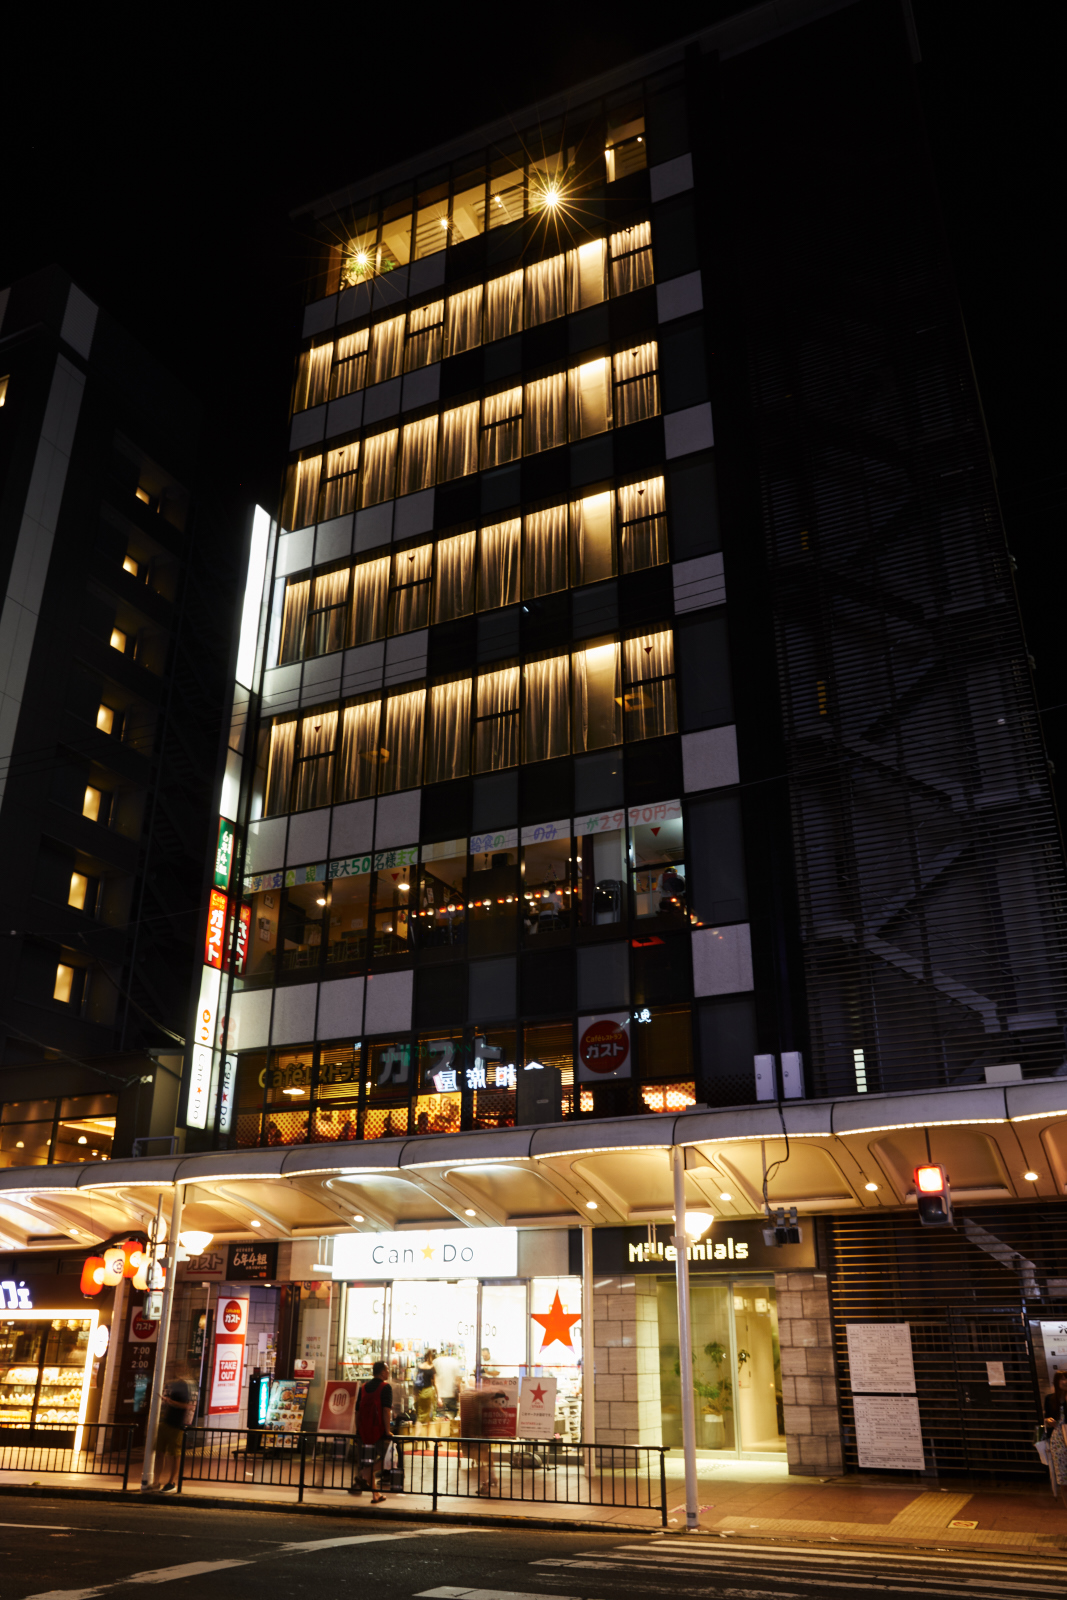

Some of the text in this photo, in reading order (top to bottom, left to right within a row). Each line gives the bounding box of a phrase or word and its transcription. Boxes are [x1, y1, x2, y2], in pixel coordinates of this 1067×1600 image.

[208, 909, 225, 962] ガスト
[586, 1042, 624, 1059] ガスト
[377, 1036, 503, 1086] ガスト
[233, 1252, 268, 1267] 6年4組
[372, 1244, 474, 1264] Can Do
[225, 1314, 241, 1324] ガスト
[135, 1321, 154, 1332] ガスト
[133, 1346, 151, 1355] 7:00
[131, 1360, 149, 1369] 2:00
[220, 1361, 237, 1371] TAKE
[220, 1371, 234, 1380] OUT
[332, 1393, 347, 1407] 100
